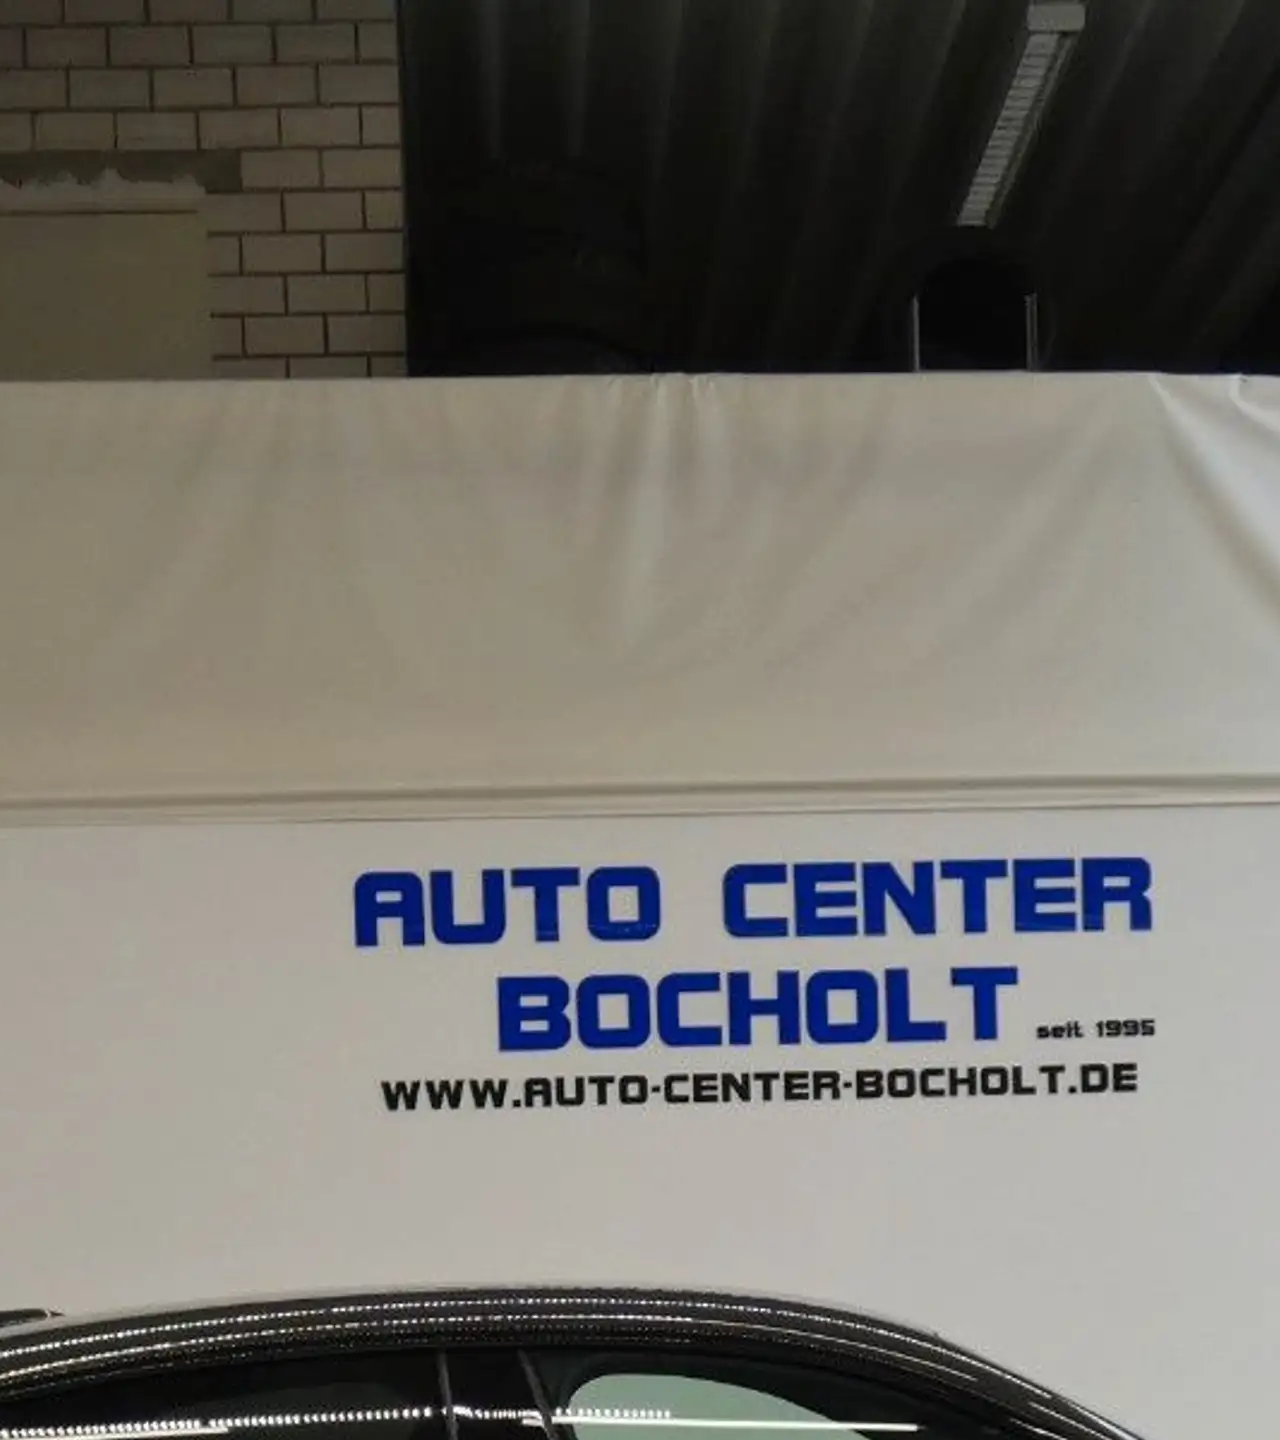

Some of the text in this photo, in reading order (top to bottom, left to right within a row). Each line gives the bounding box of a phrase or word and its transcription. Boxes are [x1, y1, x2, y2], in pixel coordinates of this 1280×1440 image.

[354, 856, 1154, 947] AUTO CENTER
[496, 966, 1156, 1053] BOCHOLT seit 1995
[380, 1061, 1139, 1112] WWW.AUTO-CENTER-BOCHOLT.DE
